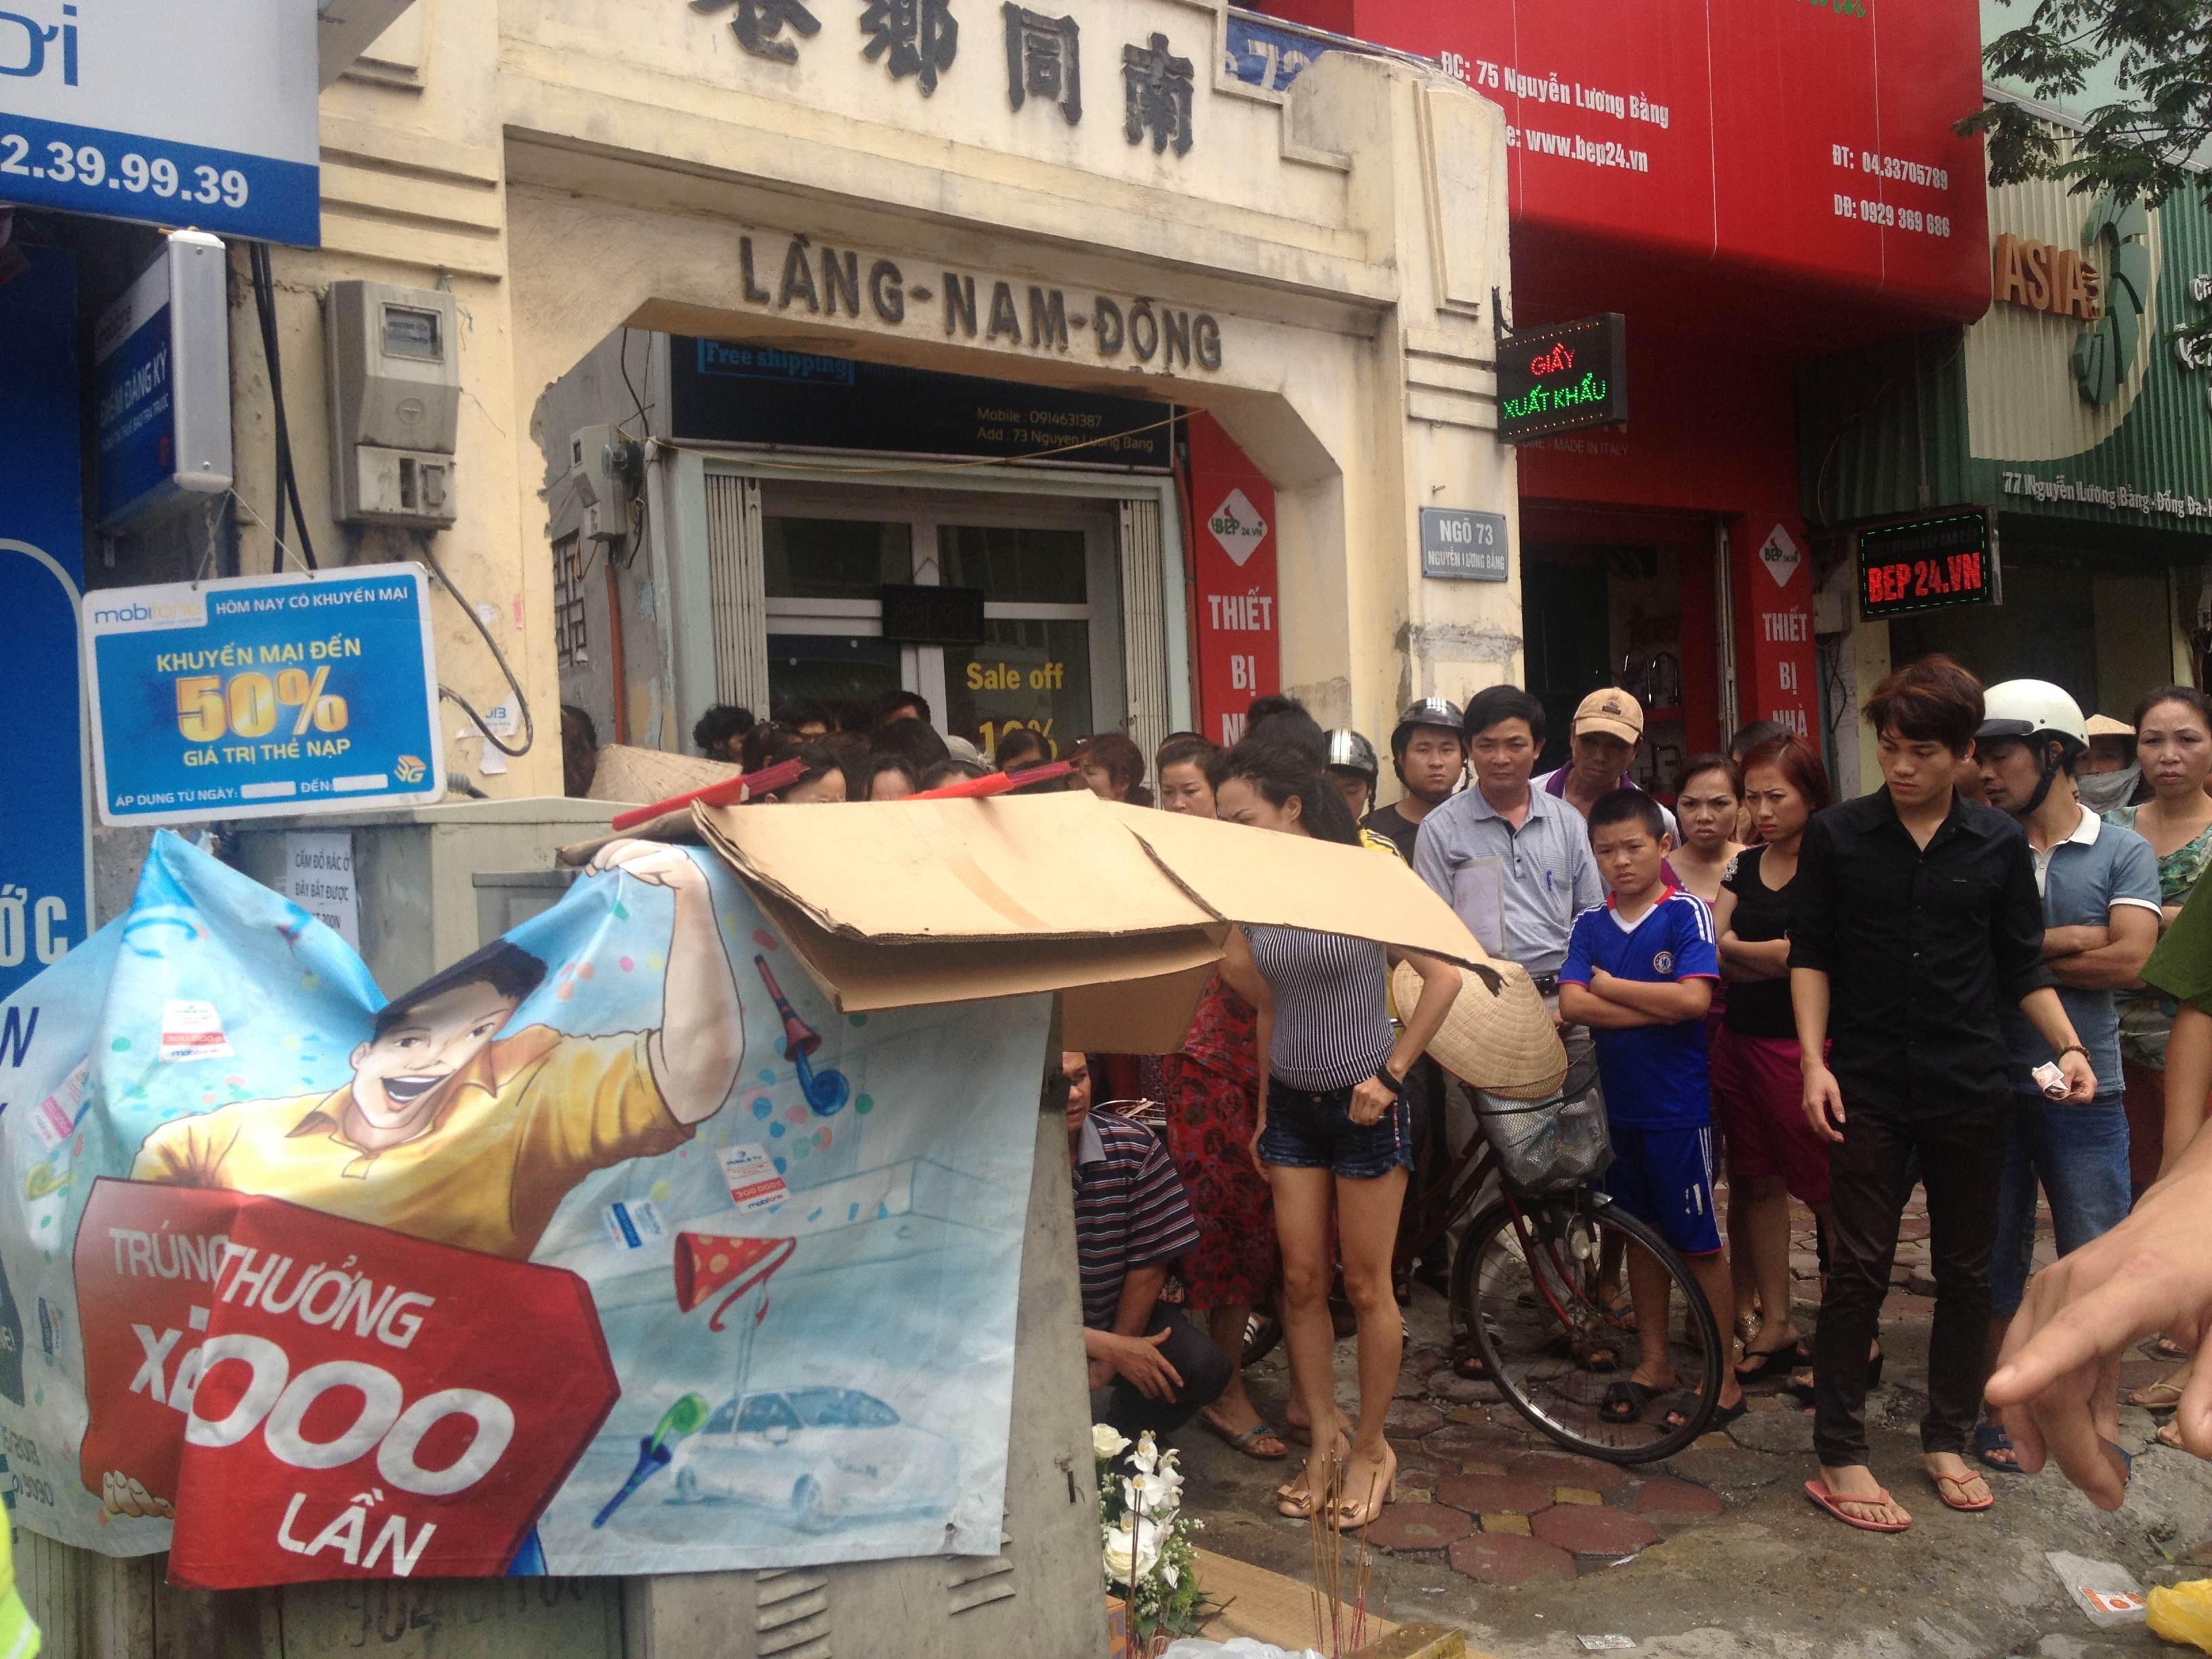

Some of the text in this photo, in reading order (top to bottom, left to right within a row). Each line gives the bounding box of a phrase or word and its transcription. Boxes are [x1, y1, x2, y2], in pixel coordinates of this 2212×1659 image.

[1477, 60, 1499, 88] 75
[1504, 66, 1570, 105] Nguyễn
[1575, 83, 1624, 120] Lương
[1629, 91, 1670, 129] Bằng
[1525, 128, 1649, 172] www.bep24.vn
[1832, 144, 1948, 190] ĐT: 04.33705789
[1860, 200, 1894, 226] 0929
[1898, 208, 1923, 232] 369
[1995, 233, 2098, 320] ASIA
[705, 340, 752, 366] Free
[758, 348, 848, 379] shipping
[1504, 372, 1606, 419] XUẤT KHẨU
[977, 408, 1021, 423] Mobile
[1030, 411, 1103, 428] 0914631387
[977, 427, 1003, 441] Add
[1013, 430, 1027, 442] 73
[1031, 430, 1079, 447] Nguyen
[1123, 436, 1154, 453] Bang
[2003, 472, 2022, 494] 77
[2024, 474, 2074, 501] Nguyễn
[1439, 517, 1494, 546] NGÕ 73
[1914, 551, 1982, 597] 24.VN
[216, 595, 250, 615] HÔM
[253, 598, 285, 613] NAY
[289, 592, 309, 608] CÓ
[312, 587, 376, 607] KHUYẾN
[1208, 586, 1273, 631] THIẾT
[1762, 605, 1808, 642] THIẾT
[157, 632, 362, 673] KHUYẾN MẠI ĐẾN
[966, 661, 1064, 691] Sale off
[1231, 654, 1256, 697] BỊ
[1779, 661, 1798, 695] BỊ
[175, 665, 350, 743] 50%
[184, 737, 351, 767] GIÁ TRỊ THẺ NẠP
[115, 794, 134, 806] ÁP
[214, 1240, 436, 1349] THƯỞNG
[276, 1487, 437, 1578] LẦN
